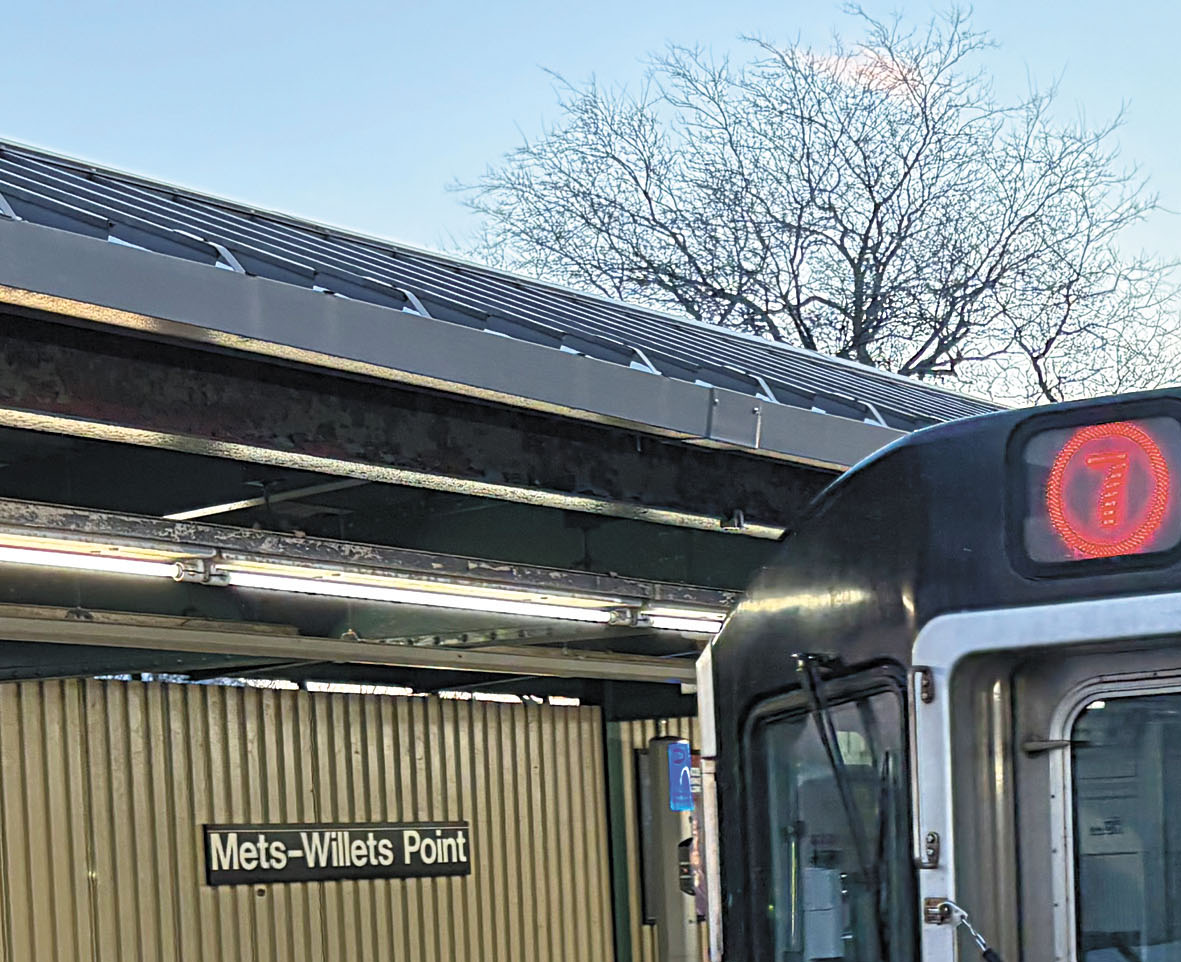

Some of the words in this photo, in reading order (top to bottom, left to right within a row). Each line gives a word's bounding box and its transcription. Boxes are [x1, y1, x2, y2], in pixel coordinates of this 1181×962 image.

[1085, 452, 1130, 527] 7
[209, 831, 395, 871] Mets-Willets
[402, 829, 468, 865] Point
